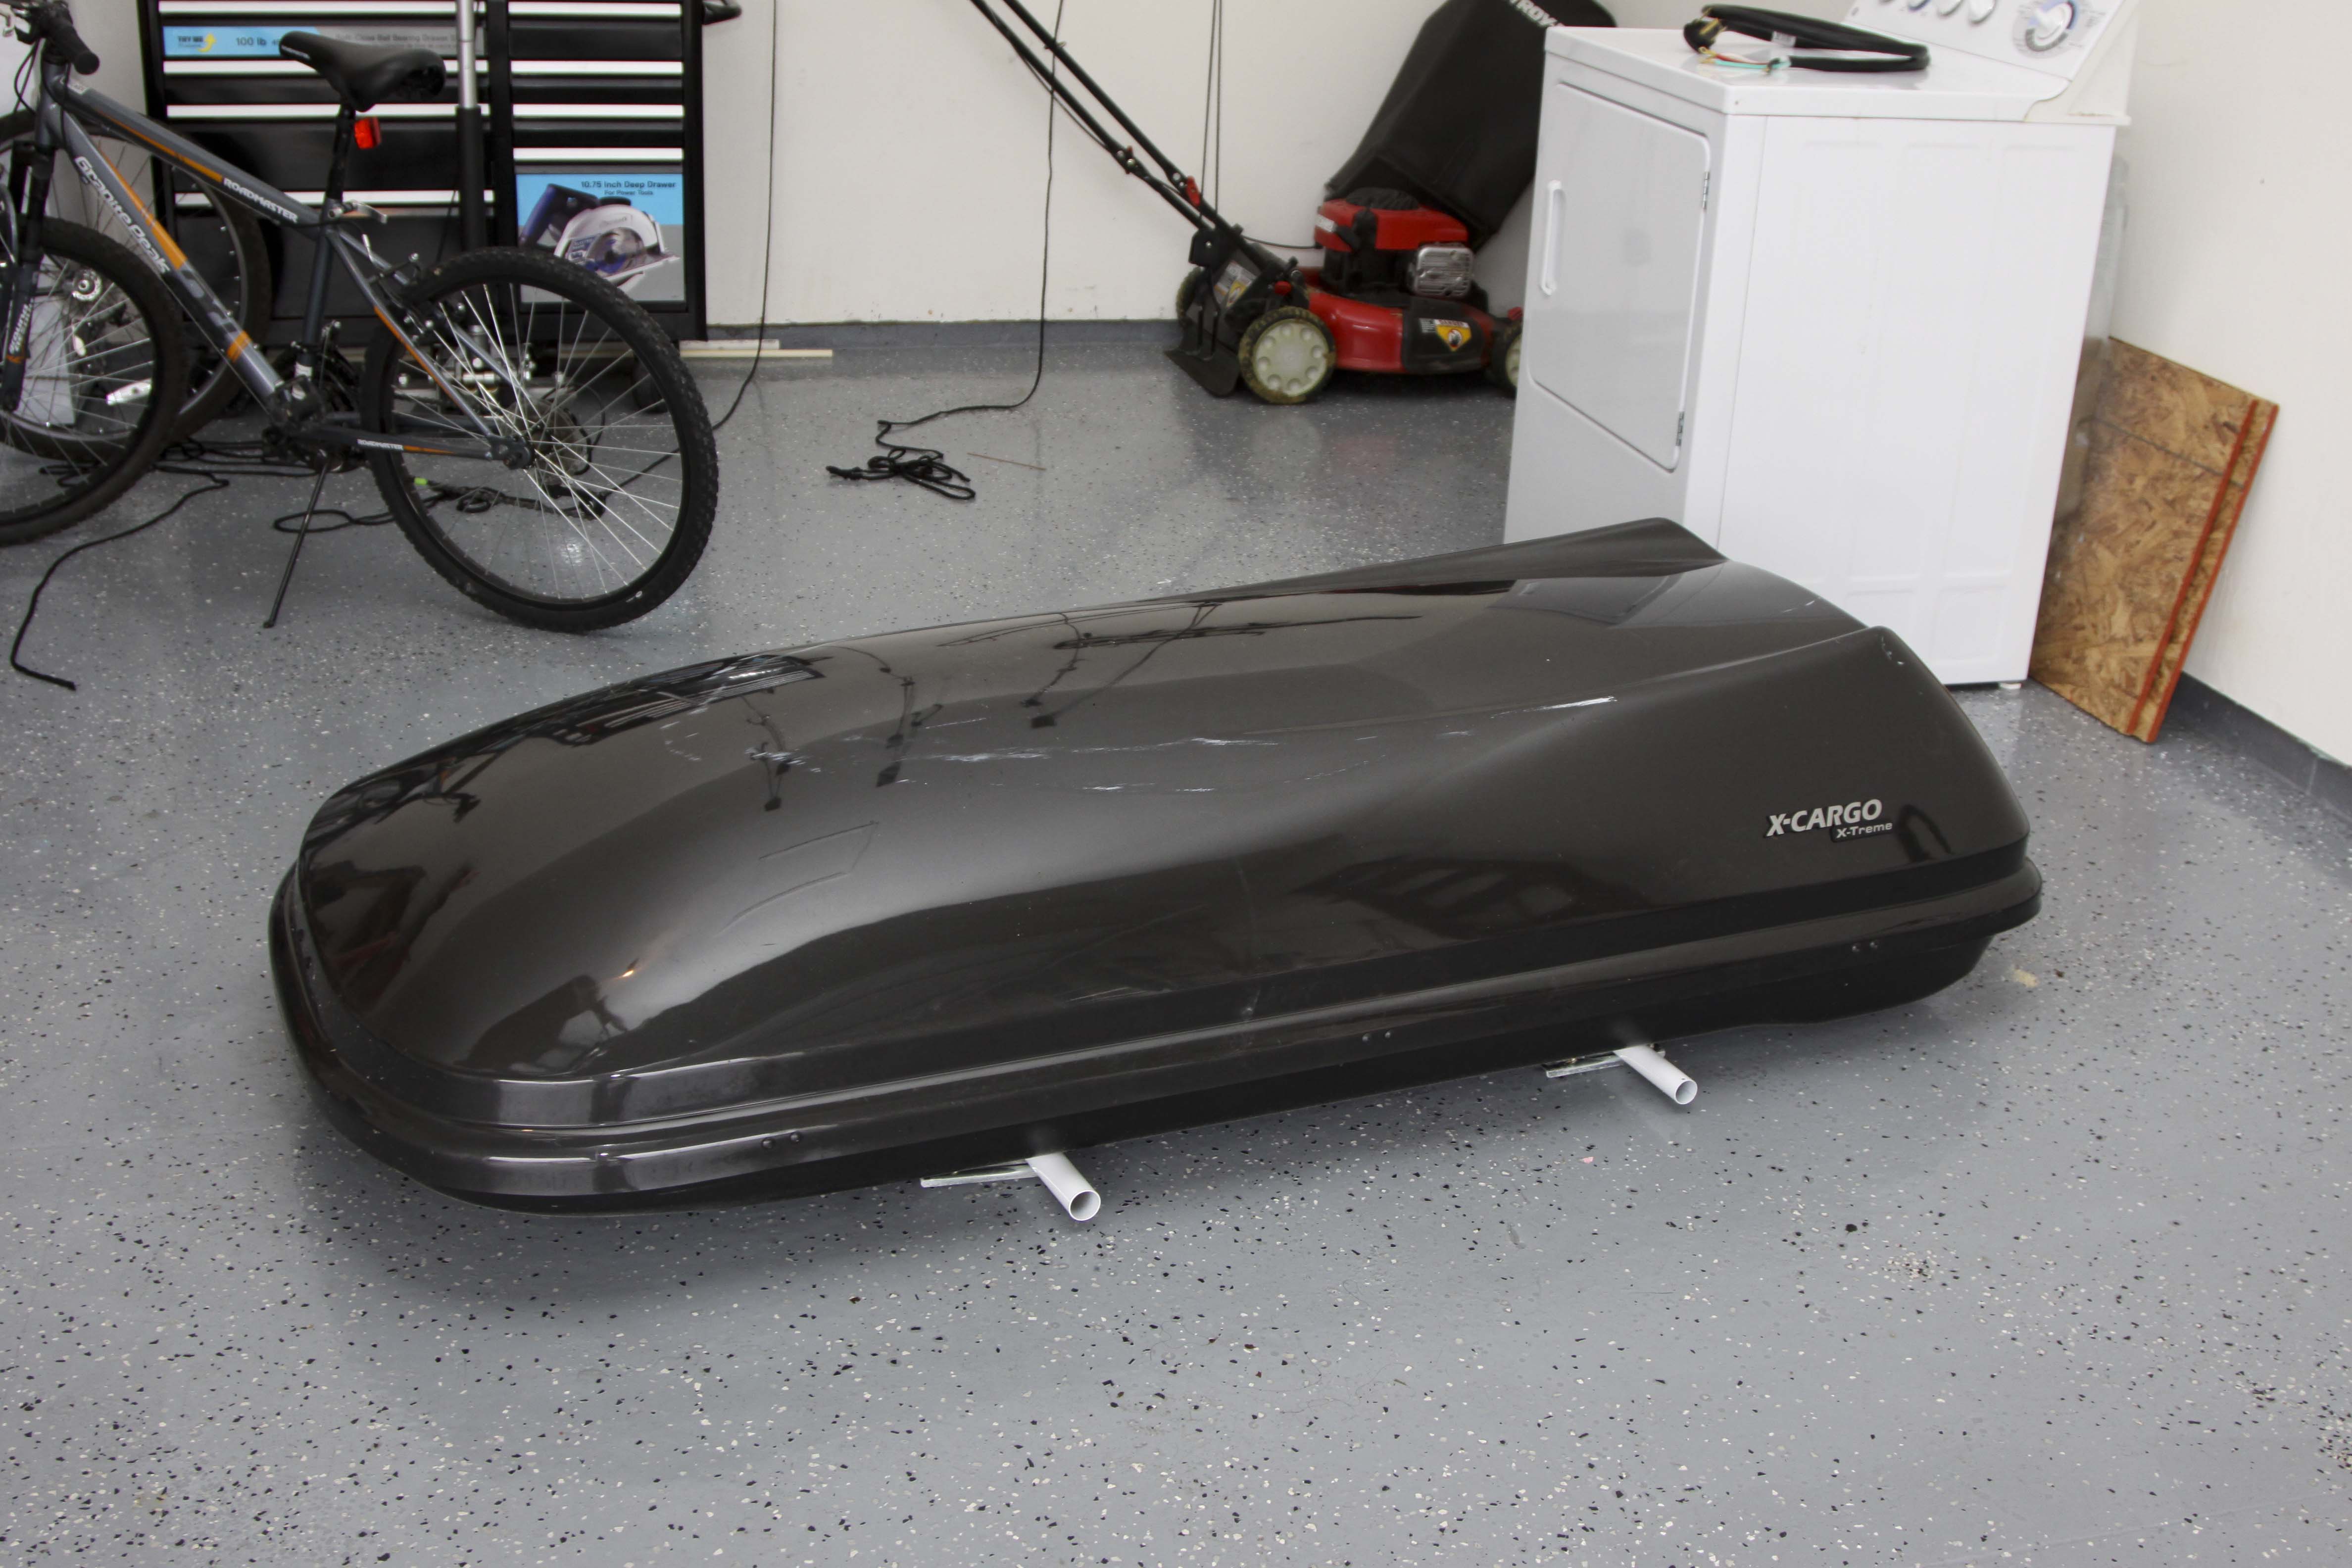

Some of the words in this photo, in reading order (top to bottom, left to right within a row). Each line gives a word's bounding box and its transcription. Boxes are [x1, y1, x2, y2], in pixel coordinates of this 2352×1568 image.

[236, 37, 253, 46] 100
[624, 181, 645, 189] Deep
[74, 156, 132, 225] Granite
[129, 224, 170, 273] Peak
[223, 178, 298, 223] ROADMASTER
[1765, 798, 1883, 837] X-CARGO
[1836, 821, 1893, 838] X-Treme
